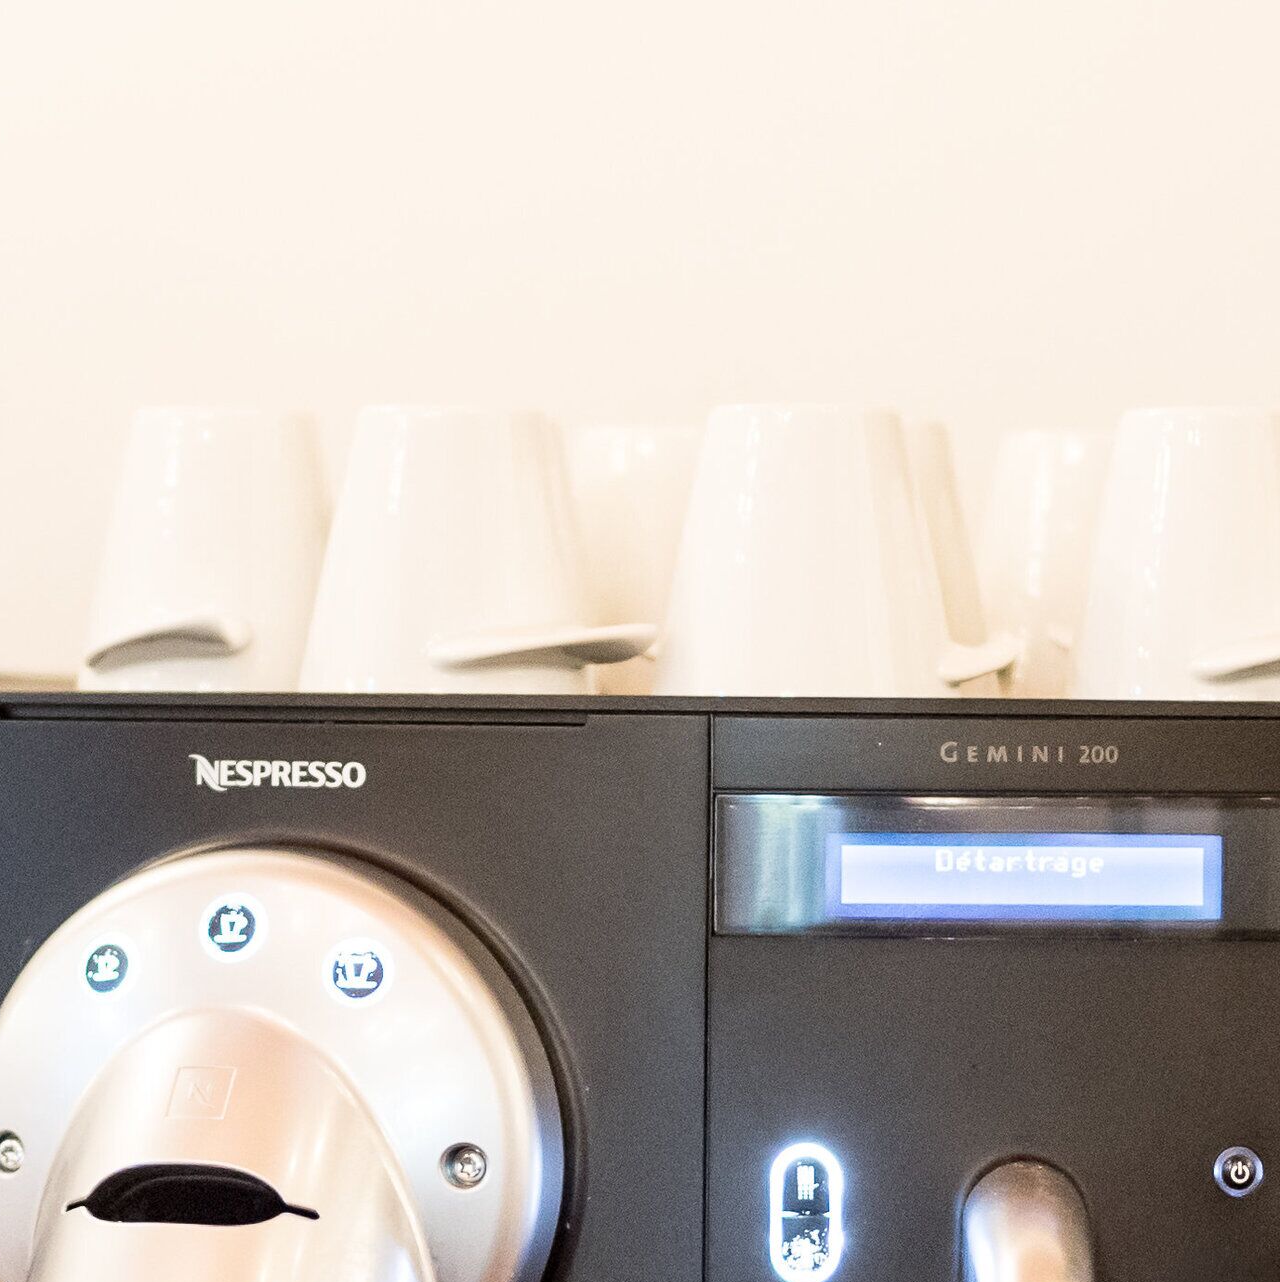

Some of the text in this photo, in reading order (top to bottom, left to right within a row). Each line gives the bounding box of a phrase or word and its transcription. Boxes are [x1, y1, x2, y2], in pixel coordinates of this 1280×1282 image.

[940, 741, 1119, 764] GEMINI 200
[188, 753, 367, 792] NESPRESSO
